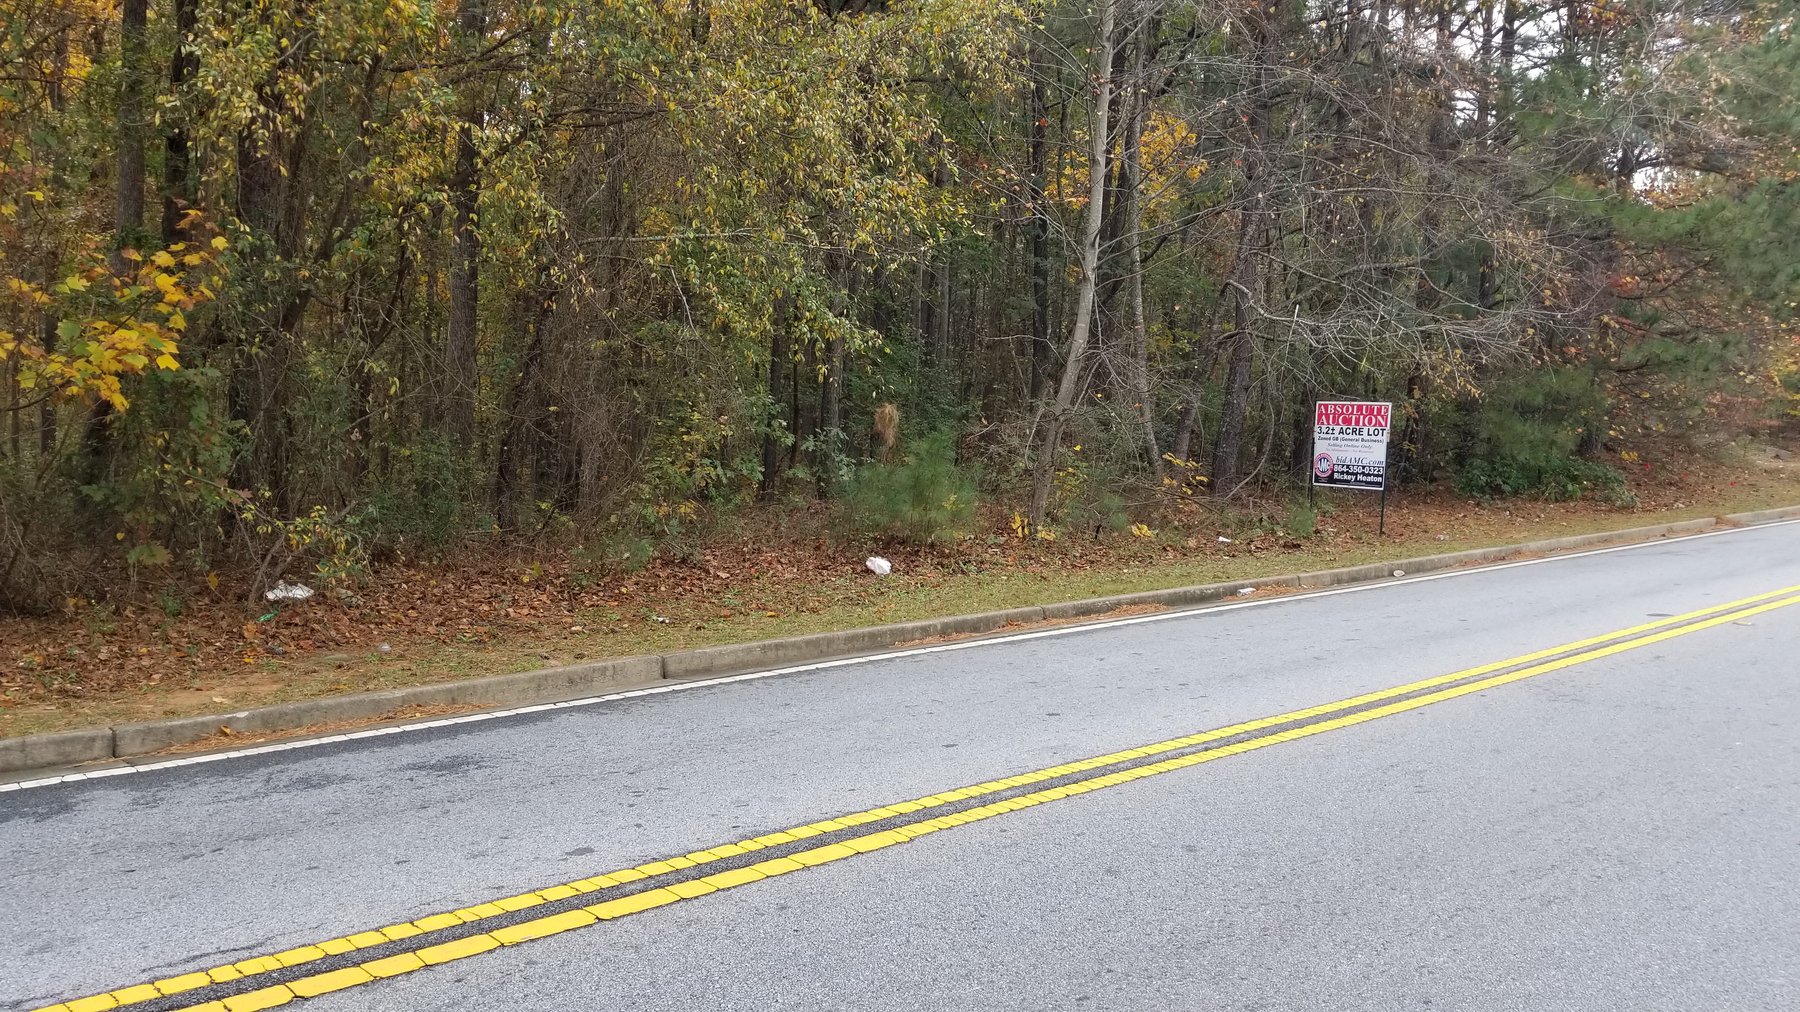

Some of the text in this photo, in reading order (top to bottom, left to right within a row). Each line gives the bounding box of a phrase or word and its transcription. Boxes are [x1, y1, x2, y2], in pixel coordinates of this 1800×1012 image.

[1319, 404, 1388, 415] ABSOLUTE
[1319, 415, 1386, 426] AUCTION
[1318, 426, 1386, 436] 3.2± ACRE LOT
[1336, 456, 1384, 466] bidAMC.com
[1334, 464, 1384, 474] 864-350-0323
[1334, 472, 1356, 482] Rickey
[1358, 474, 1382, 482] Heaton
